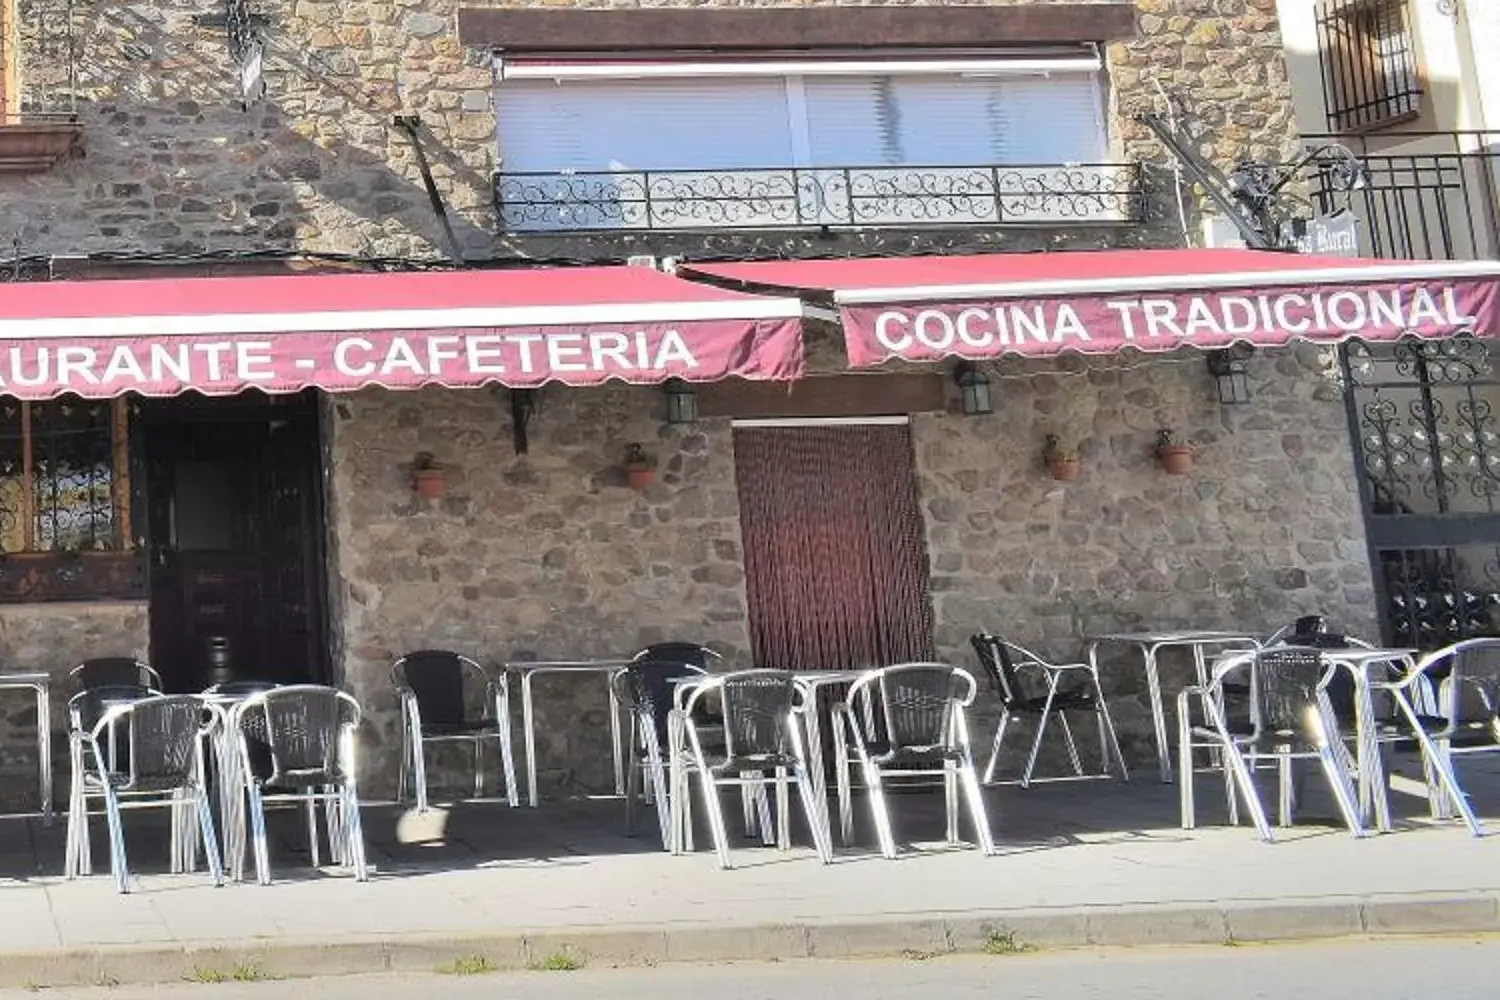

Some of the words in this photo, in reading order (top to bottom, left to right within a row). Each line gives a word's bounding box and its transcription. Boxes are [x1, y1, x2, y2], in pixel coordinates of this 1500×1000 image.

[875, 304, 1092, 351] COCINA
[1106, 287, 1478, 339] TRADICIONAL
[295, 359, 315, 368] -
[334, 330, 699, 377] CAFETERIA
